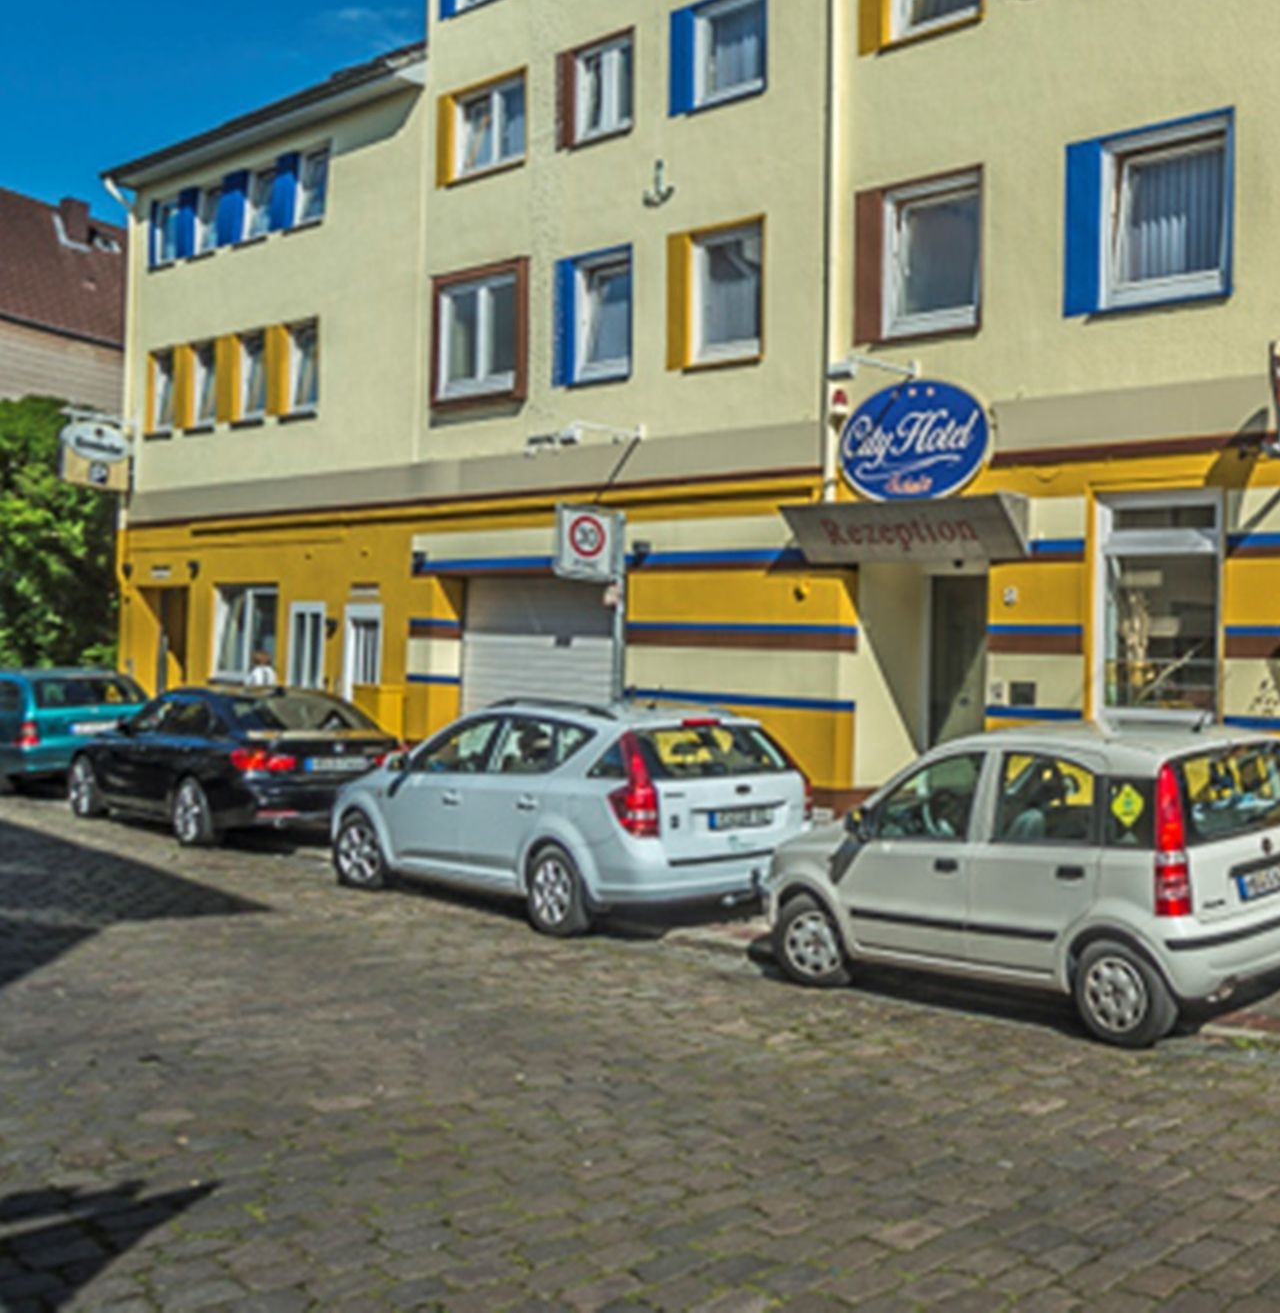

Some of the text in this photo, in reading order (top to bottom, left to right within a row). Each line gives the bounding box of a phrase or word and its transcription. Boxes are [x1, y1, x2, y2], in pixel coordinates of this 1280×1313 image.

[842, 408, 980, 469] City Hotel
[818, 514, 978, 553] Rezeption
